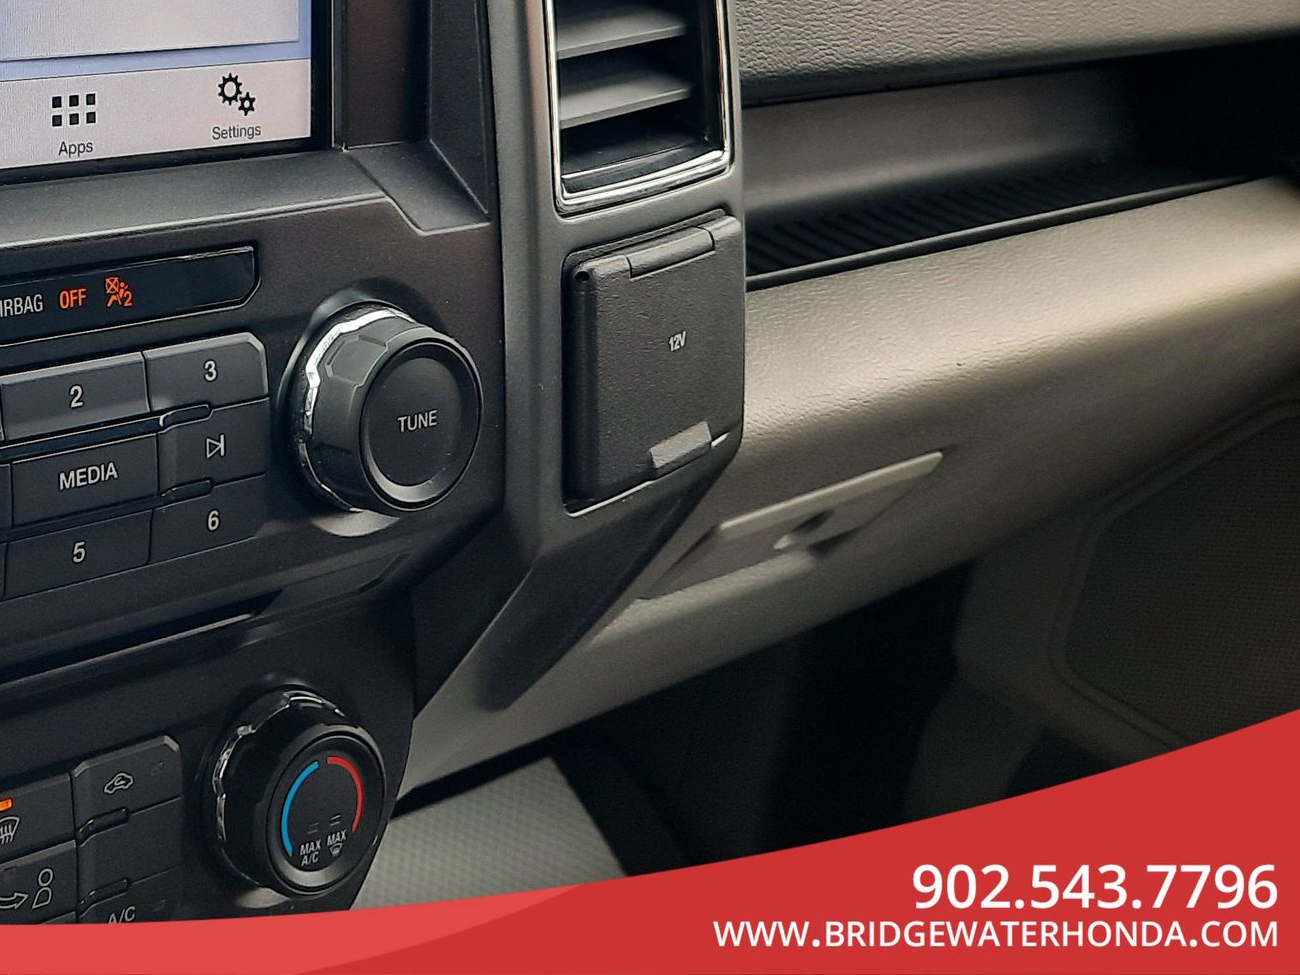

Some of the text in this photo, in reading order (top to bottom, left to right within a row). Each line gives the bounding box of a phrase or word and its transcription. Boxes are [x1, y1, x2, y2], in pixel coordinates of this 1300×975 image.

[211, 123, 262, 143] Settings
[58, 139, 94, 158] Apps
[59, 288, 88, 309] OFF
[668, 330, 687, 352] 12V
[204, 360, 217, 382] 3
[69, 385, 84, 408] 2
[397, 409, 438, 433] TUNE
[58, 461, 119, 491] MEDIA
[207, 510, 220, 531] 6
[72, 541, 87, 564] 5
[300, 840, 321, 855] MAX
[327, 830, 347, 846] MAX
[301, 851, 320, 867] A/C
[108, 905, 136, 924] A/C
